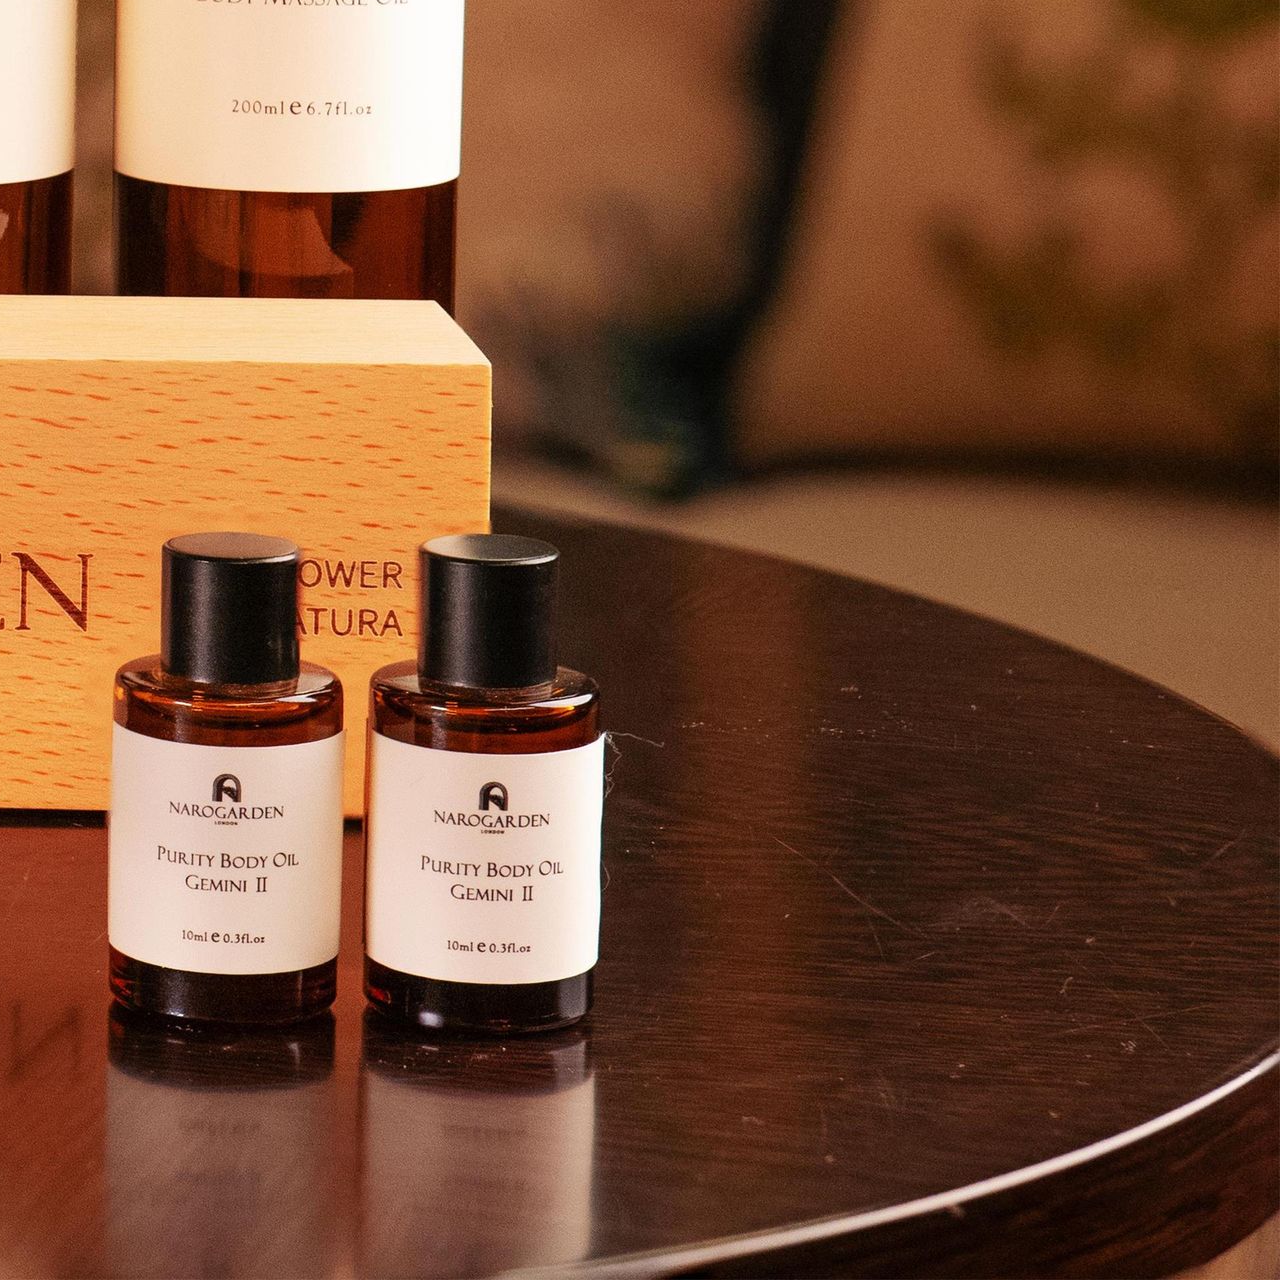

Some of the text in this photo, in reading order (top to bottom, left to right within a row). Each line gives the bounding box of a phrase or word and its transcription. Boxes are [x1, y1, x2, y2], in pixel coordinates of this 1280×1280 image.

[231, 99, 285, 115] 200ml
[169, 801, 284, 820] NAROGARDEN
[433, 809, 550, 829] NAROGARDEN
[182, 929, 208, 943] 10ml
[447, 939, 474, 953] 10ml
